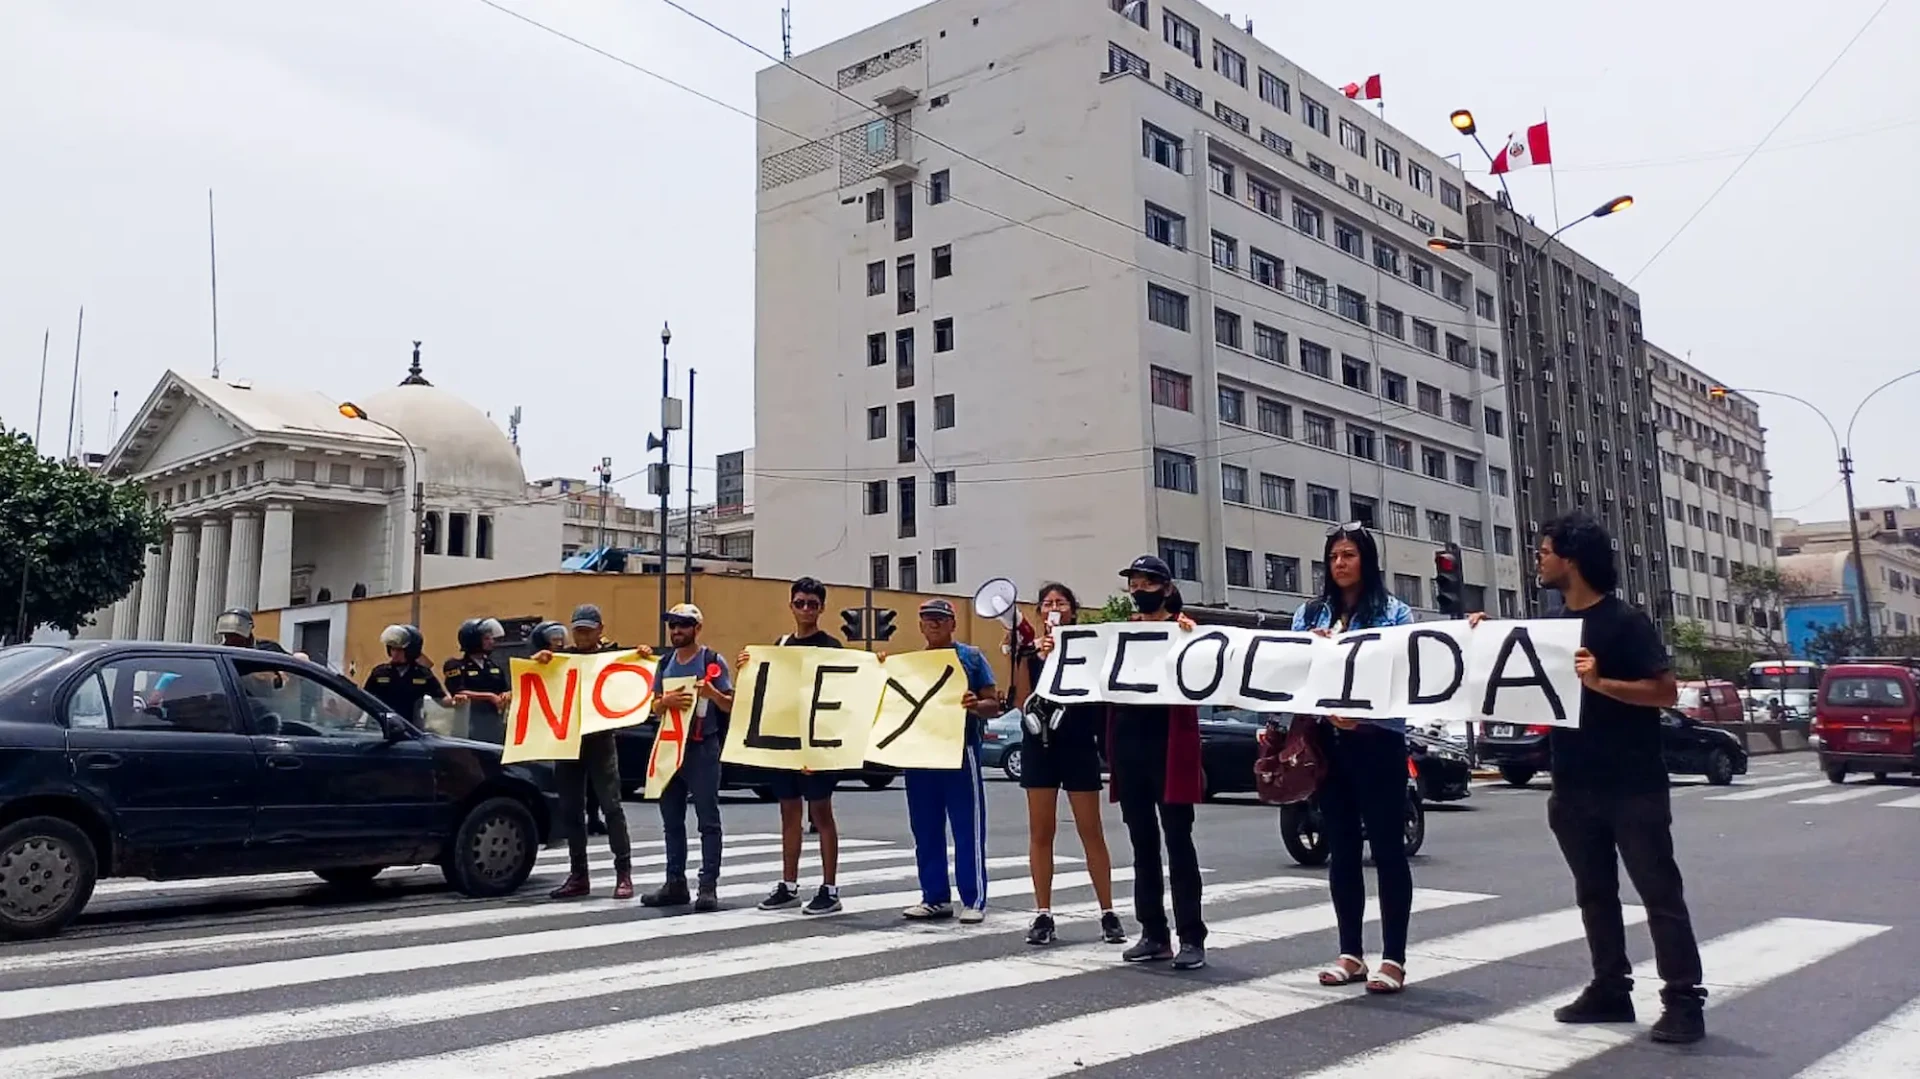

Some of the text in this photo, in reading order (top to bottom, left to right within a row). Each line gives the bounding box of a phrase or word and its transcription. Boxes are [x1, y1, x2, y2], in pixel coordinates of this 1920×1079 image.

[514, 662, 655, 746] NO
[743, 661, 954, 749] LEY
[1051, 626, 1566, 720] ECOCIDA
[649, 704, 684, 777] A
